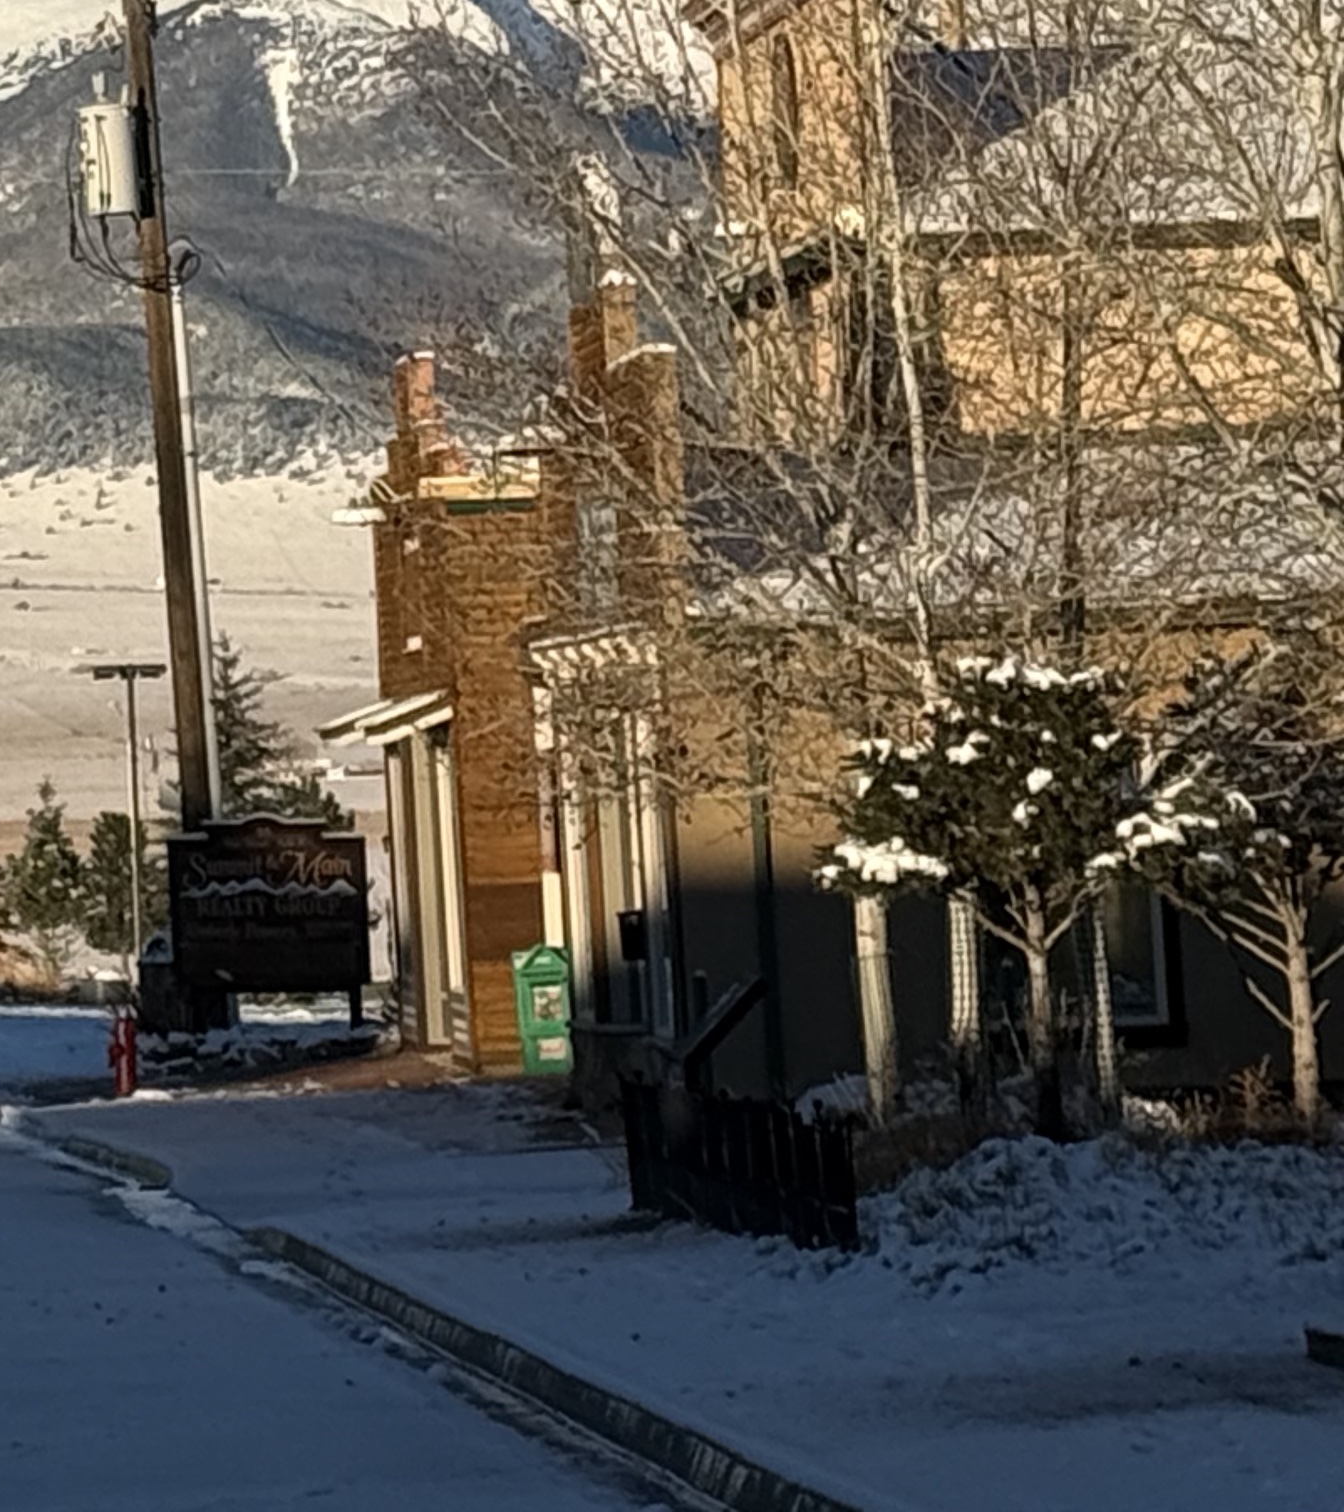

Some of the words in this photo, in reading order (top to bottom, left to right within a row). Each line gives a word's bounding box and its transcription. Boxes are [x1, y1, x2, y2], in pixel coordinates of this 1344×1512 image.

[275, 849, 353, 886] Main
[197, 895, 268, 917] REALTY
[273, 895, 340, 917] GROUP
